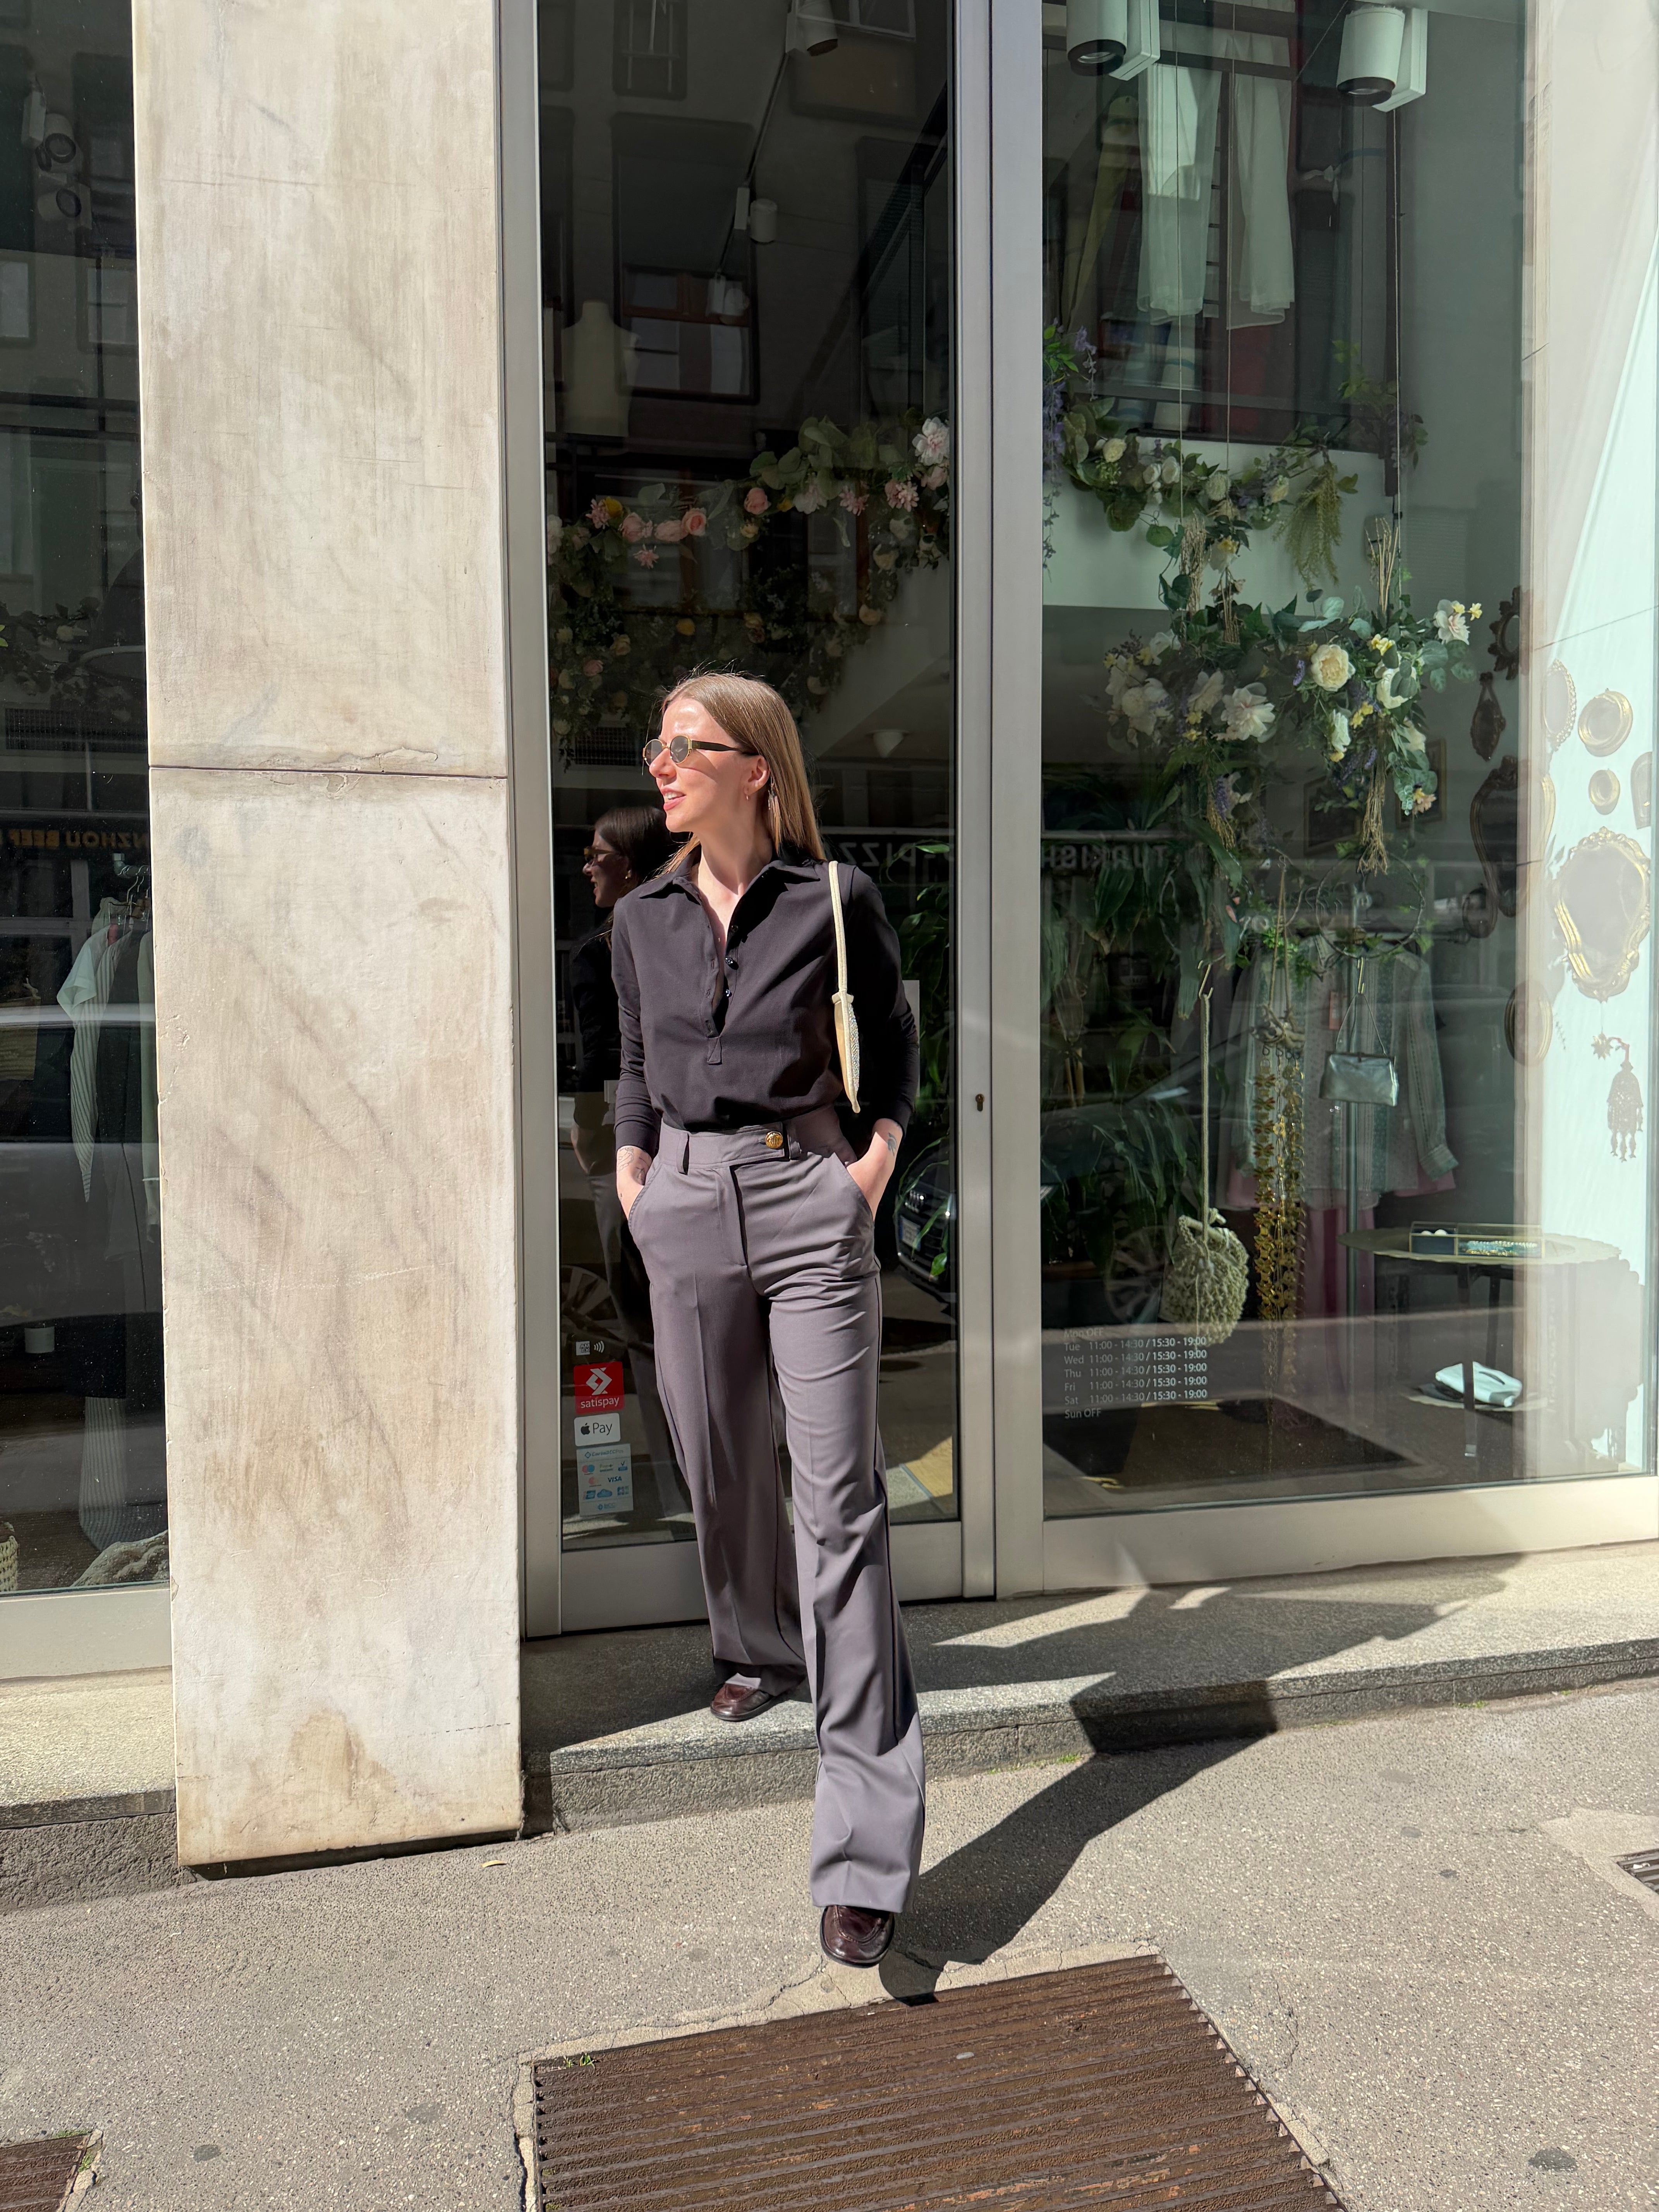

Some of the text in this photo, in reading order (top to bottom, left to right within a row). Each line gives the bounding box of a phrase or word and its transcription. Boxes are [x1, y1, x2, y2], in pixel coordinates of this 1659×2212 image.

[1064, 1328, 1104, 1338] Mon OFF
[1064, 1342, 1080, 1351] Tue
[1089, 1341, 1112, 1350] 11:00
[1120, 1339, 1144, 1348] 14:30
[1146, 1338, 1150, 1348] /
[1152, 1338, 1176, 1347] 15:30
[1183, 1336, 1207, 1346] 19:00
[1064, 1355, 1084, 1364] Wed
[1090, 1354, 1113, 1363] 11:00
[1121, 1352, 1144, 1362] 14:30
[1146, 1352, 1150, 1362] /
[1152, 1351, 1176, 1361] 15:30
[1183, 1350, 1207, 1359] 19:00
[1064, 1369, 1081, 1378] Thu
[1090, 1367, 1113, 1377] 11:00
[1121, 1366, 1144, 1375] 14:30
[1146, 1365, 1151, 1374] /
[1152, 1364, 1176, 1374] 15:30
[1183, 1363, 1207, 1372] 19:00
[1064, 1382, 1075, 1391] Fri
[1090, 1381, 1113, 1390] 11:00
[1121, 1379, 1145, 1388] 14:30
[1146, 1378, 1151, 1388] /
[1152, 1377, 1176, 1387] 15:30
[1183, 1376, 1207, 1386] 19:00
[580, 1396, 619, 1408] satispay
[1065, 1396, 1078, 1405] Sat
[1090, 1394, 1113, 1404] 11:00
[1121, 1392, 1145, 1401] 14:30
[1146, 1391, 1151, 1401] /
[1153, 1391, 1176, 1401] 15:30
[1184, 1389, 1207, 1399] 19:00
[1065, 1408, 1101, 1419] Sun OFF
[593, 1422, 612, 1435] Pay
